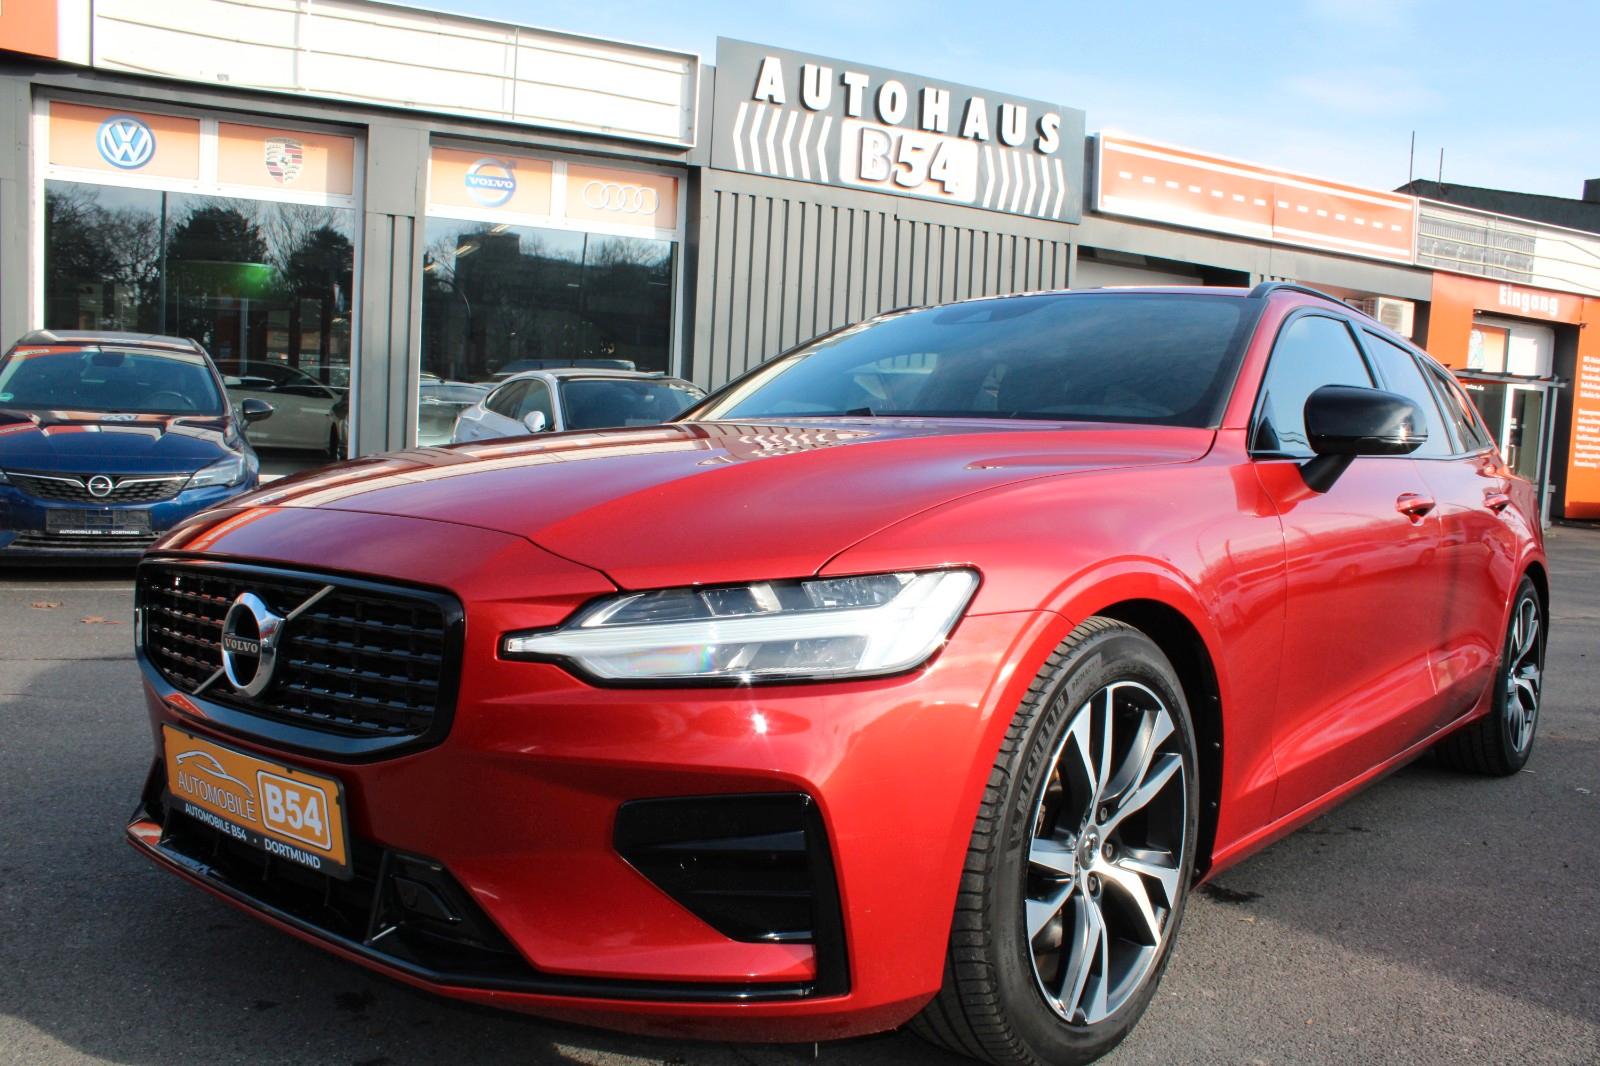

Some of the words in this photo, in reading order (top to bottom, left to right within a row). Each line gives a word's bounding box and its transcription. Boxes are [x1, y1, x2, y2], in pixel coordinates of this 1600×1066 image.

[753, 56, 1062, 154] AUTOHAUS
[468, 176, 514, 189] VOLVO
[859, 126, 960, 194] B54
[225, 638, 258, 653] VOLVO
[1016, 687, 1070, 816] MICHELIN
[177, 771, 257, 822] AUTOMOBILE
[264, 782, 323, 836] B54
[185, 803, 230, 834] AUTOMOBILE
[231, 824, 248, 841] B54
[264, 838, 320, 869] DORTMUND
